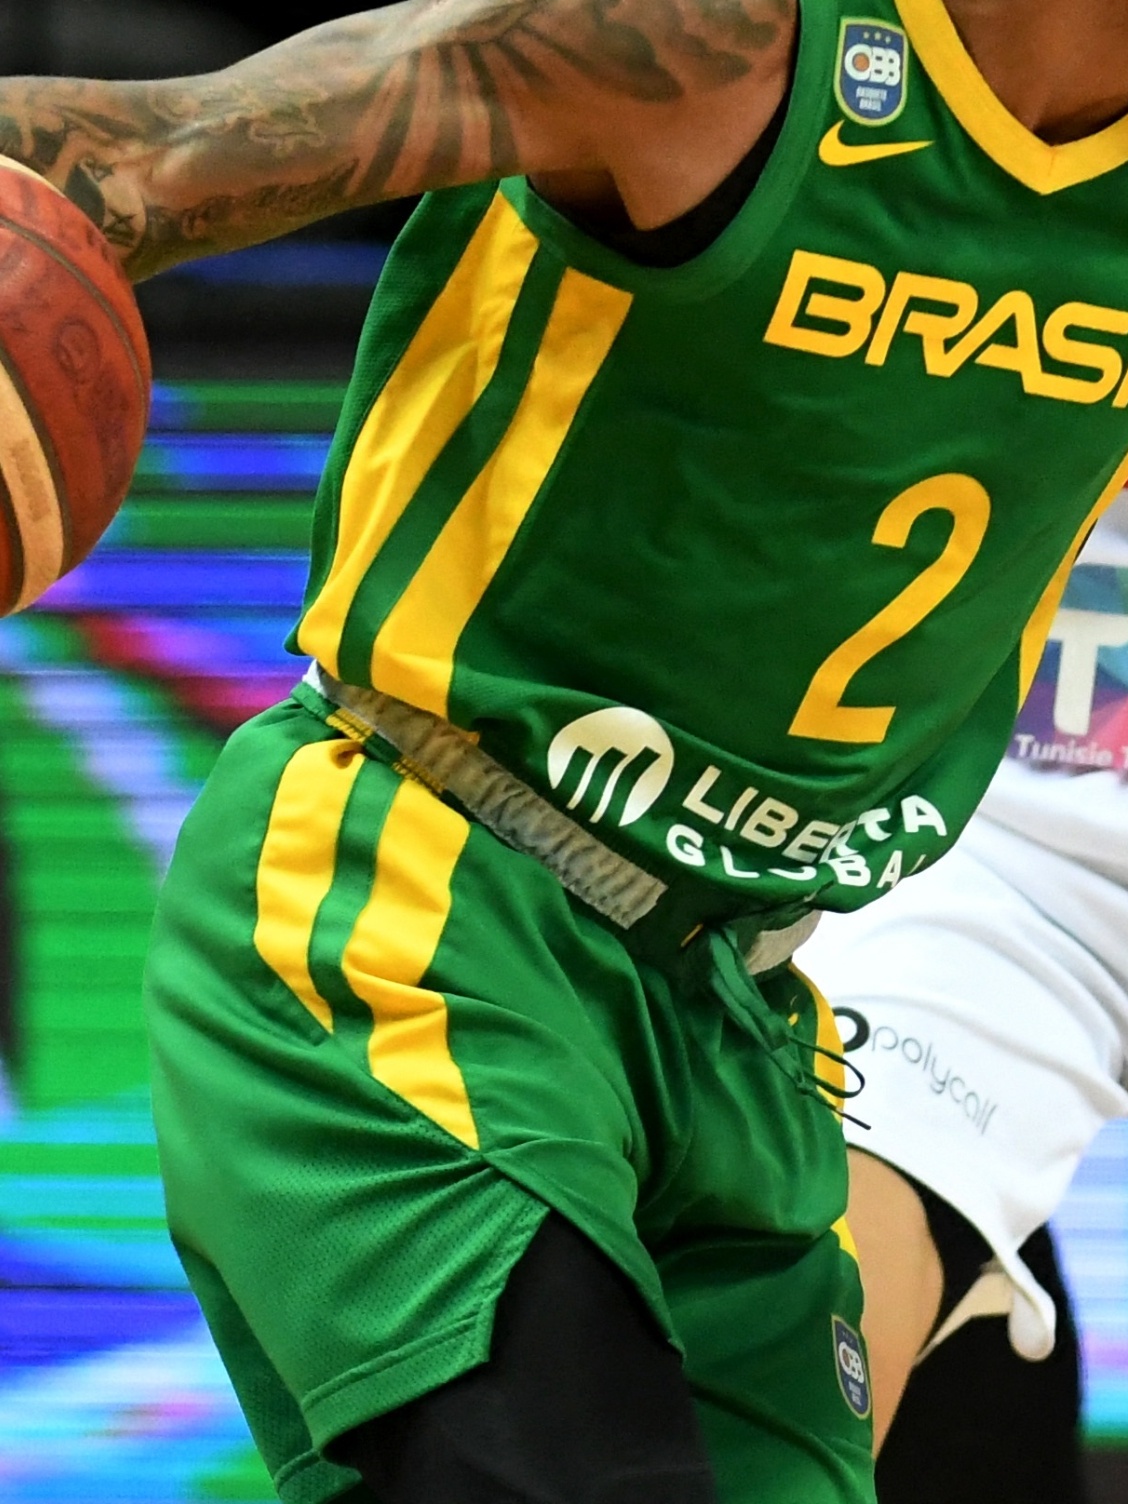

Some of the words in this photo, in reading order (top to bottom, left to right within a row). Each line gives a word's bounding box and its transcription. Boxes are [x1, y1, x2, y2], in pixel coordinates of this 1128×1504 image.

[787, 473, 991, 743] 2
[1014, 733, 1114, 768] Tunisie
[682, 764, 948, 864] LIBERTA
[871, 1025, 998, 1136] polycall
